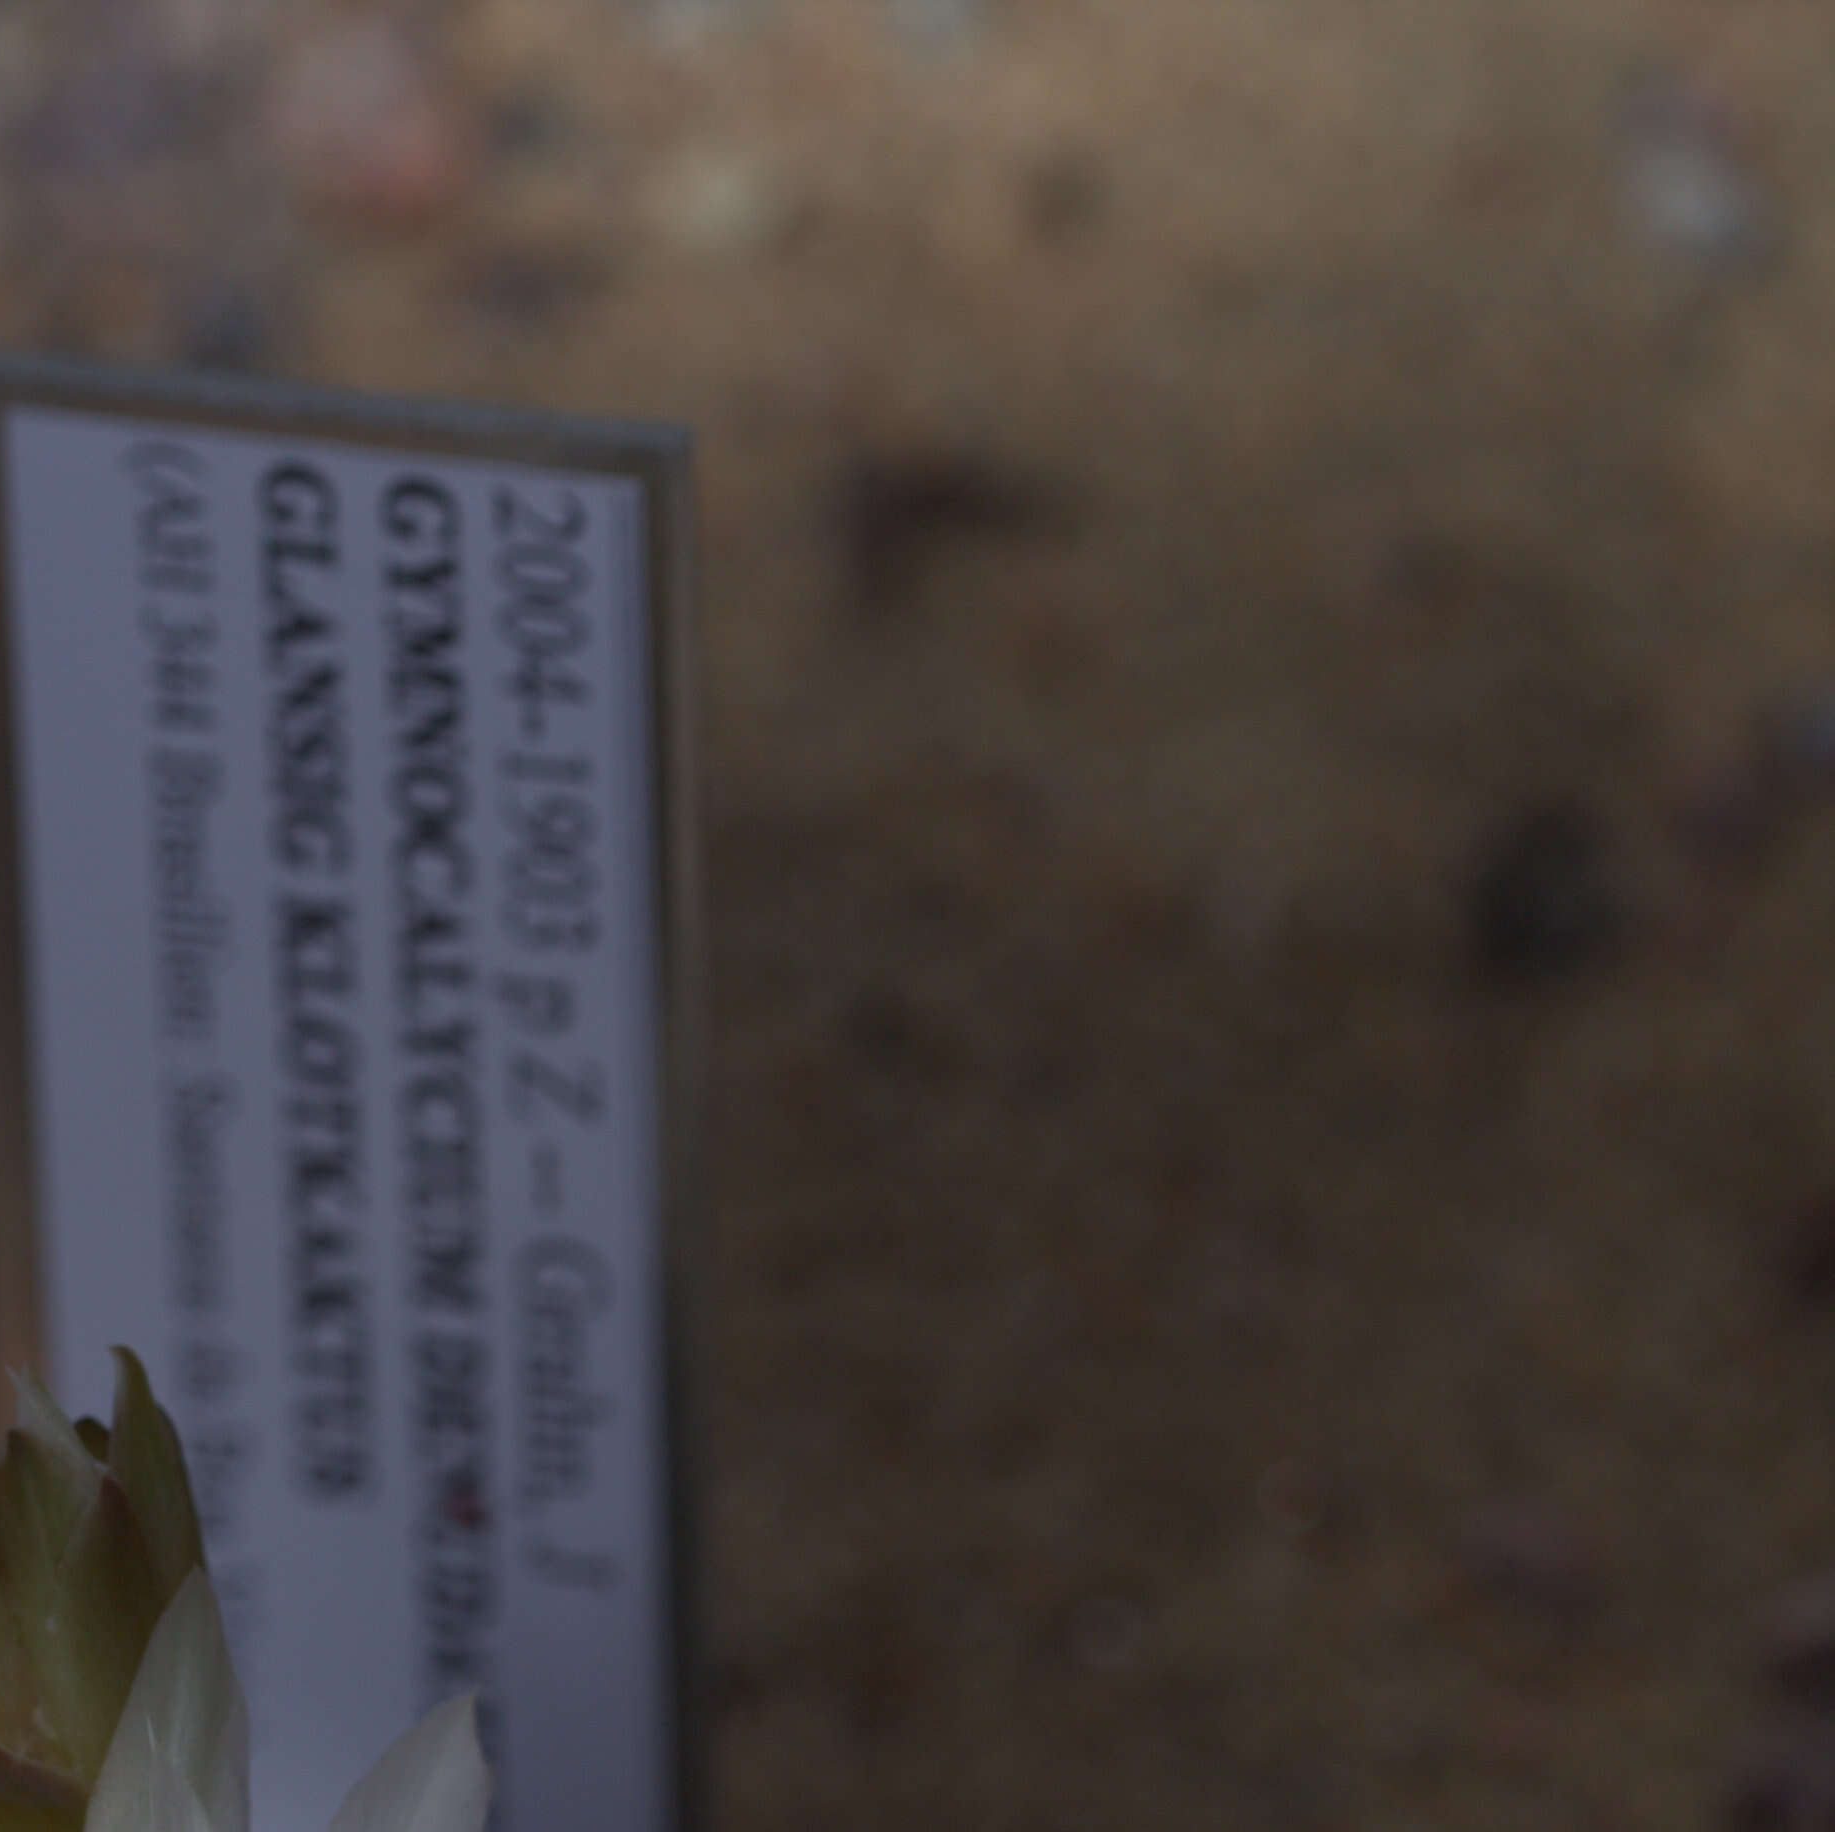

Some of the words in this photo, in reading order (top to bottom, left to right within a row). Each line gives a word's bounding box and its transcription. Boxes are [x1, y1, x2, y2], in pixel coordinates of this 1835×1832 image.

[252, 464, 356, 875] GLANSIG
[376, 476, 496, 1318] GYMNOCALYCIUM
[491, 485, 604, 954] 2004-1903
